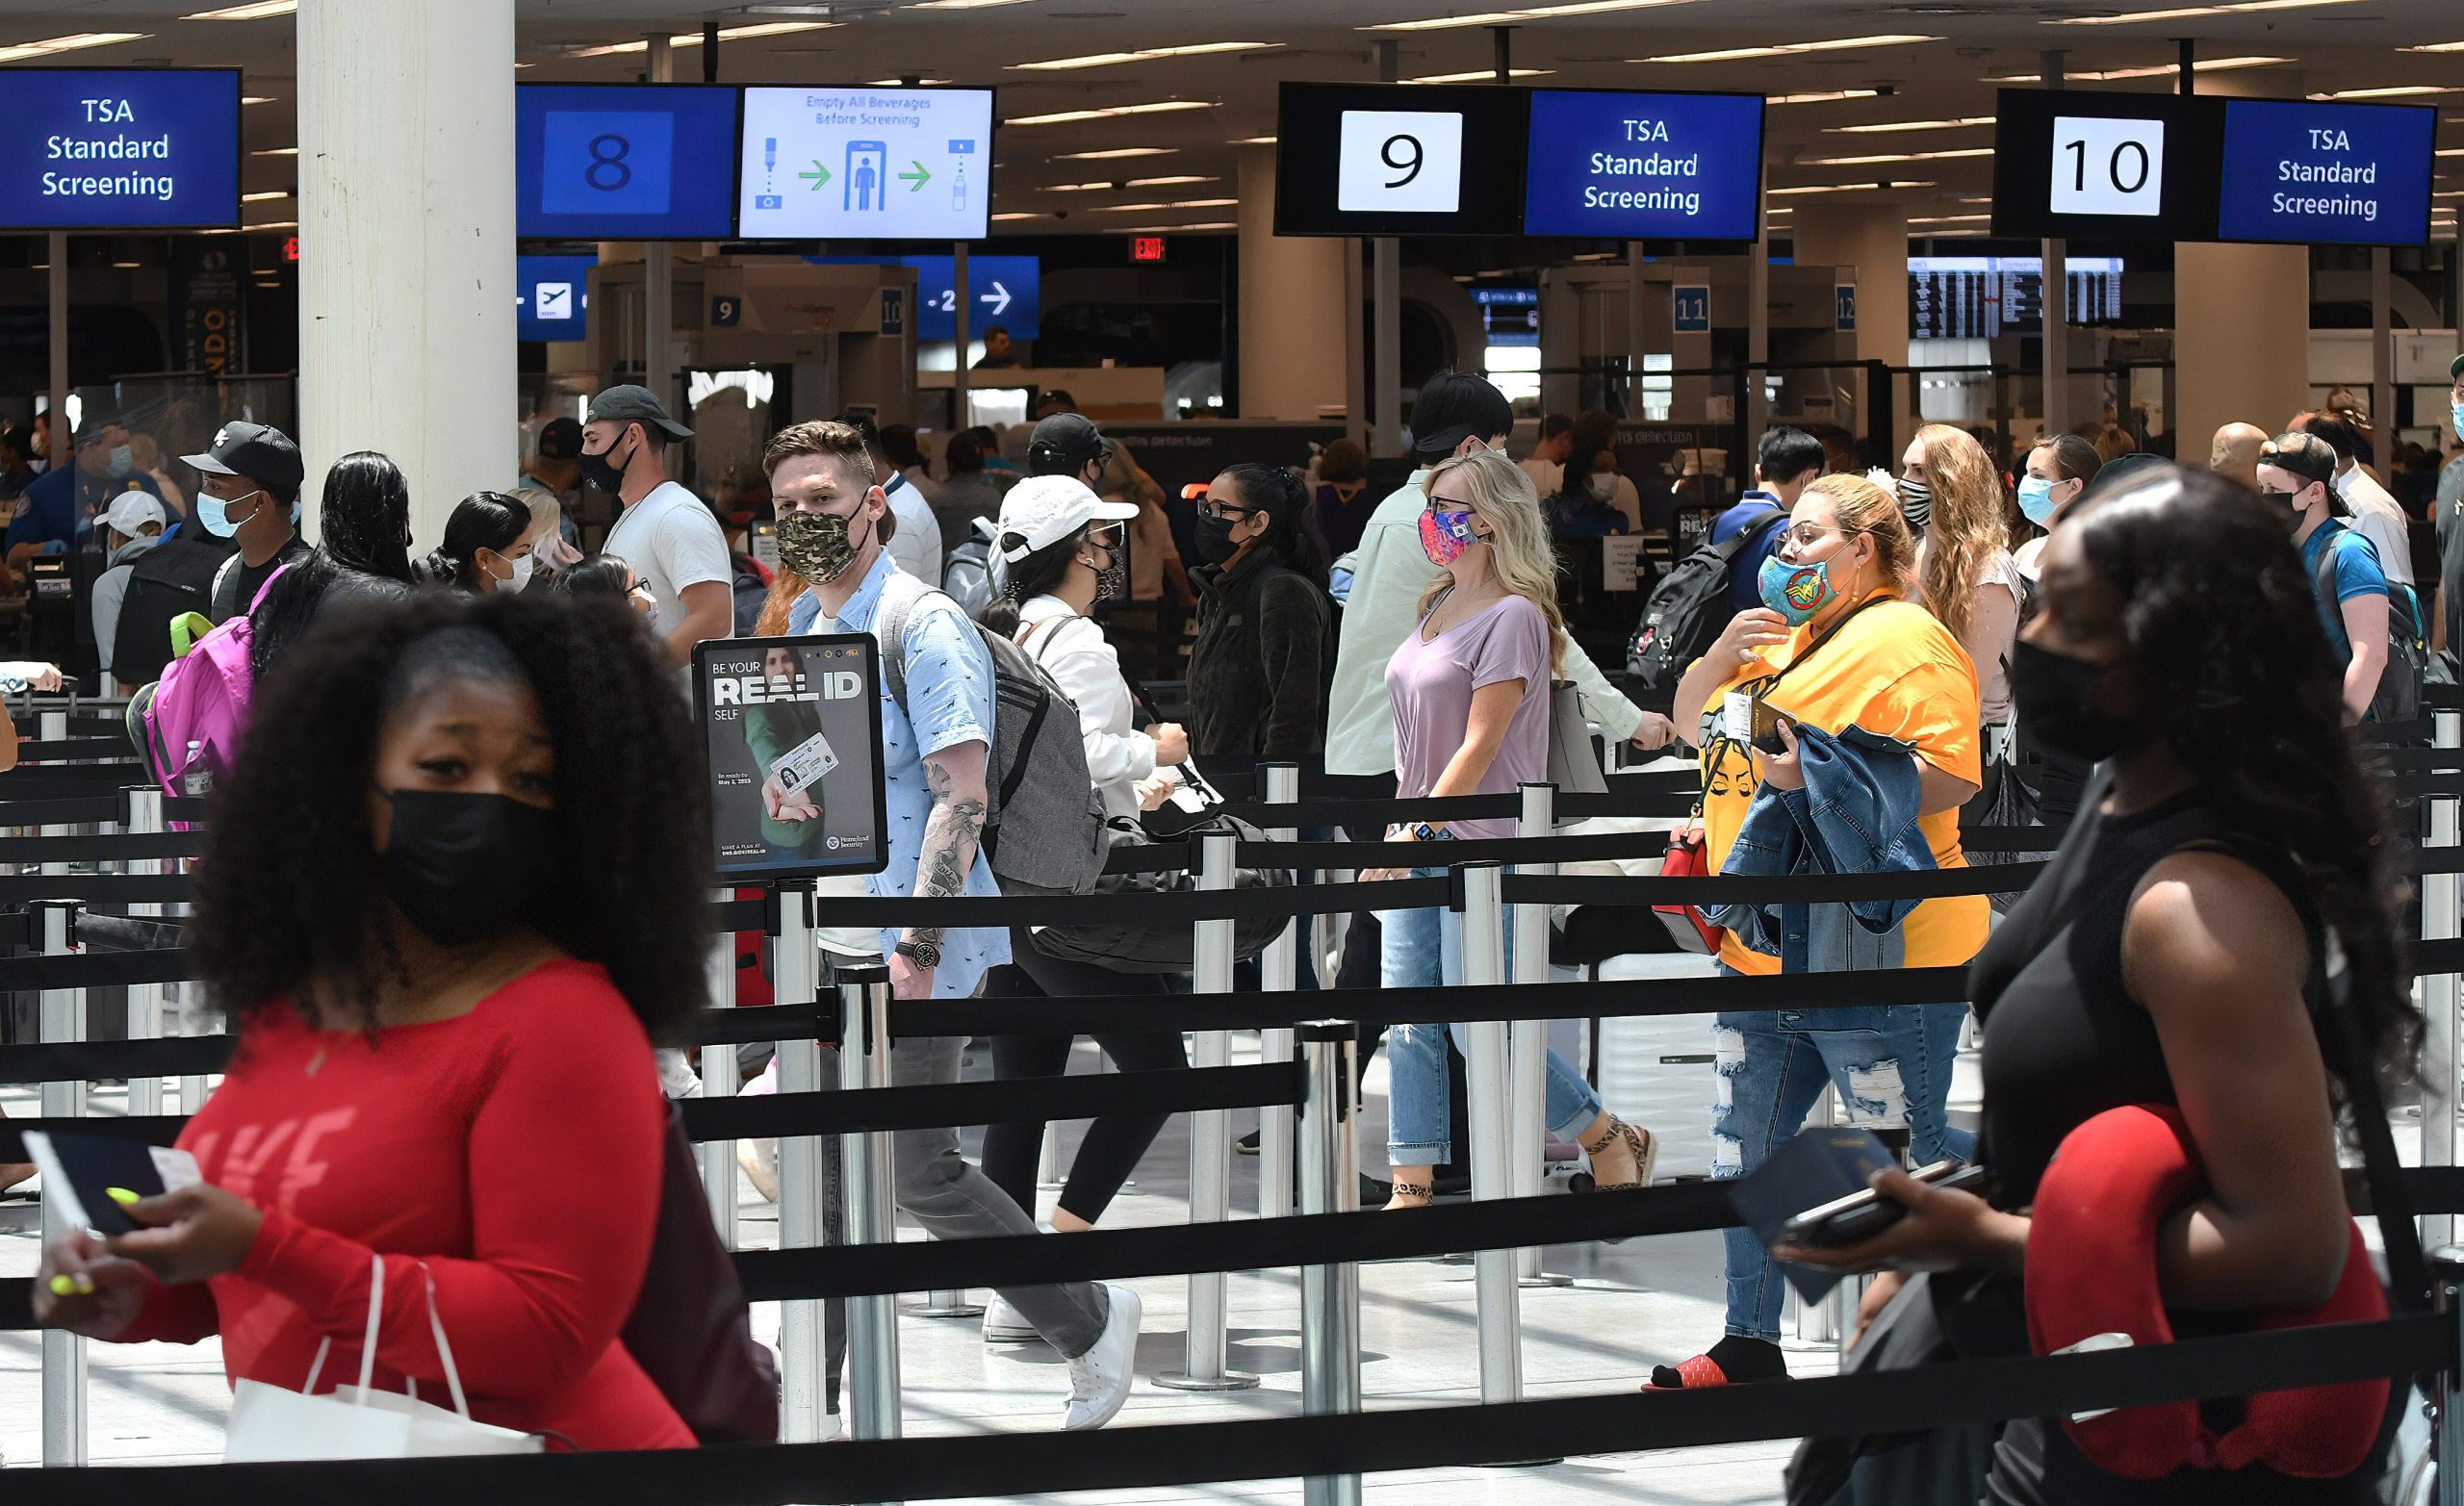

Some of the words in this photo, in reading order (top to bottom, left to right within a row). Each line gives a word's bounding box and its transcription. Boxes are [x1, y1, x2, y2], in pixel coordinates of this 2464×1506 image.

[82, 99, 134, 122] TSA
[807, 95, 845, 111] Empty
[849, 96, 866, 108] All
[868, 96, 931, 111] Beverages
[815, 112, 857, 124] Before
[860, 113, 920, 128] Screening
[1623, 119, 1669, 142] TSA
[47, 133, 168, 160] Standard
[2308, 129, 2350, 151] TSA
[585, 134, 631, 191] 8
[1381, 135, 1423, 188] 9
[1590, 152, 1698, 177] Standard
[2066, 140, 2148, 192] 10
[2278, 160, 2376, 184] Standard
[42, 170, 173, 201] Screening
[1584, 186, 1700, 216] Screening
[2272, 191, 2377, 220] Screening
[719, 301, 732, 319] 9
[883, 301, 902, 323] 10
[1678, 298, 1707, 320] 11
[1838, 297, 1855, 319] 12
[712, 663, 726, 674] BE
[729, 661, 760, 674] YOUR
[713, 674, 819, 705] REAL
[823, 671, 862, 700] ID
[714, 709, 739, 721] SELF
[840, 834, 869, 843] Homeland
